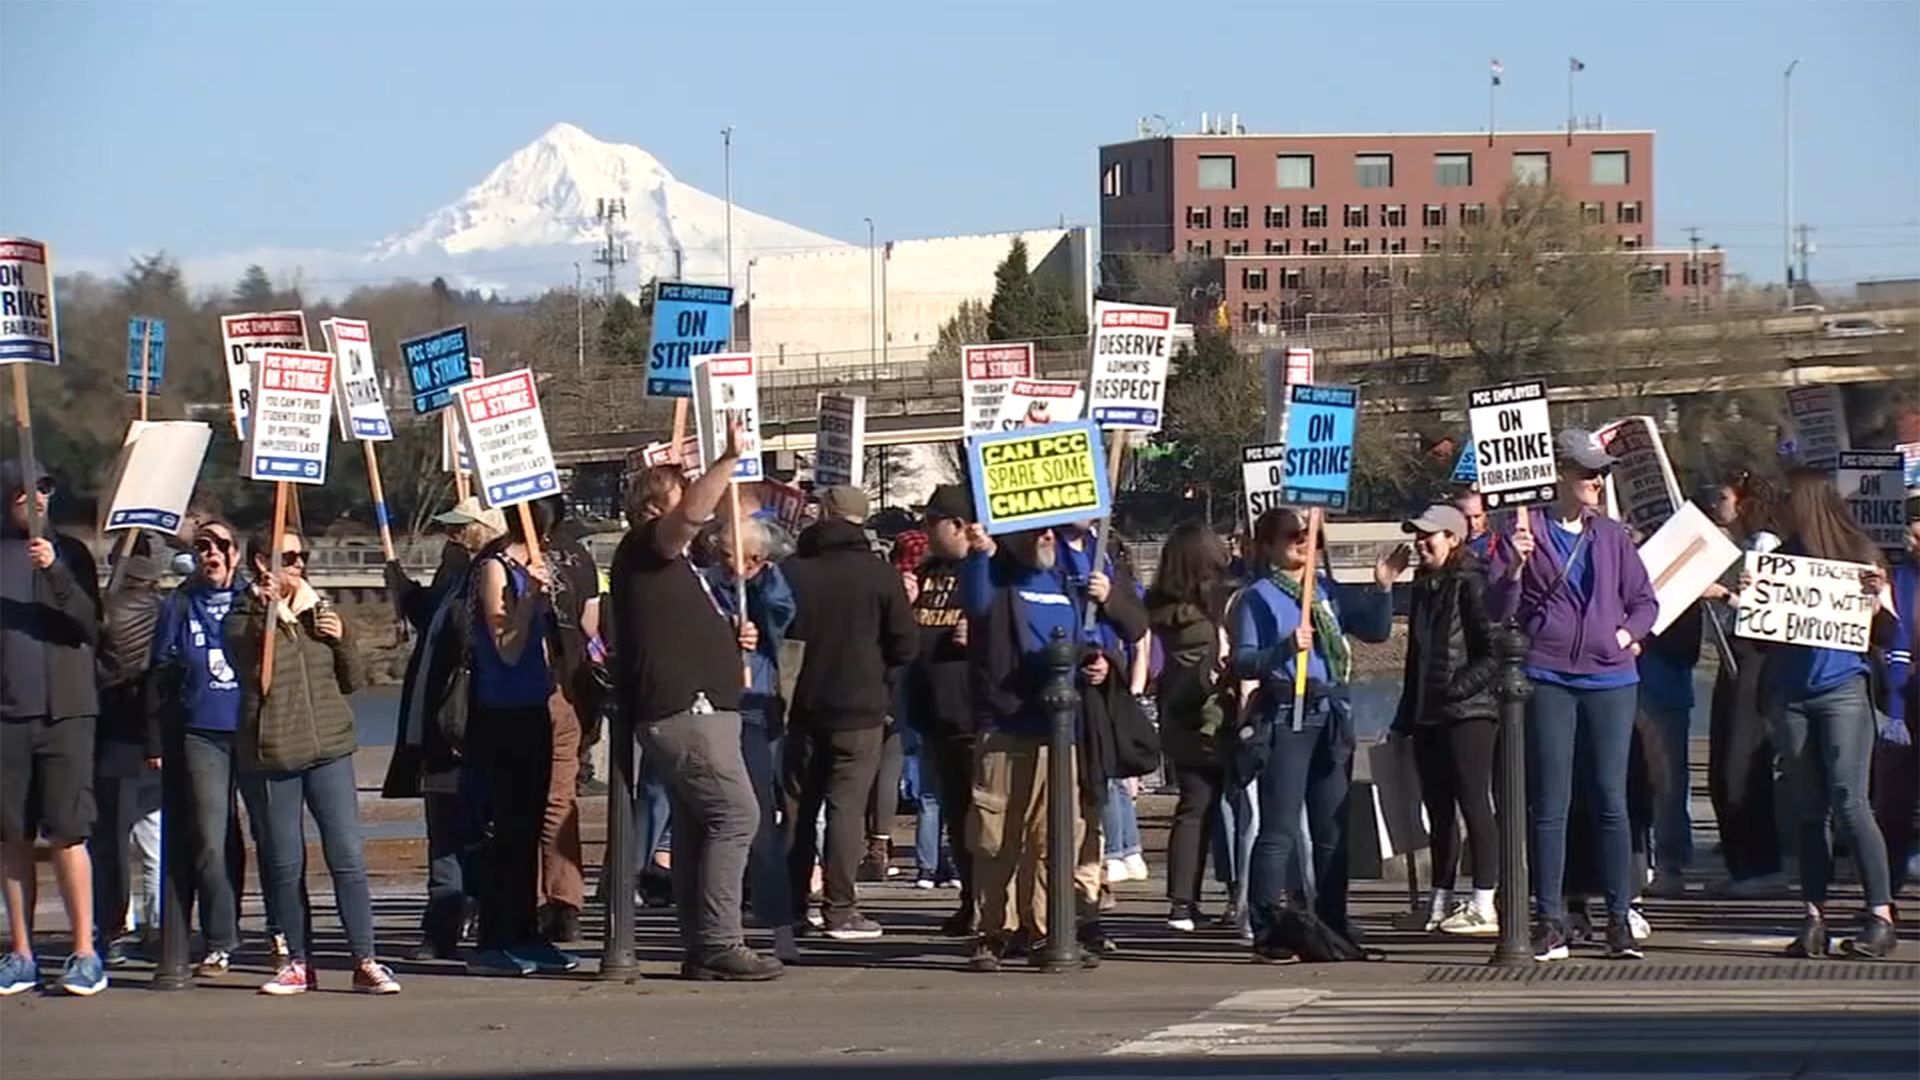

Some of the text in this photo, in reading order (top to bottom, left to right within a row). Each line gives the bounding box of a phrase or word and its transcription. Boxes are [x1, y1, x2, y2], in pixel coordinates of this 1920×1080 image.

[662, 287, 730, 302] PCC EMPLOYEES
[231, 319, 300, 335] PCC EMPLOYEES
[677, 310, 707, 338] ON
[1104, 312, 1164, 327] PCC EMPLOYEES
[407, 333, 464, 363] PCC EMPLOYEES
[969, 350, 986, 362] PCC
[1099, 334, 1165, 357] DESERVE
[267, 355, 328, 372] PCC EMPLOYEES
[412, 353, 468, 391] ON STRIKE
[969, 360, 1027, 377] ON STRIKE
[1106, 360, 1150, 375] ADMIN'S
[265, 370, 327, 392] ON STRIKE
[466, 387, 482, 402] PCC
[482, 378, 527, 400] EMPLOYEES
[1014, 382, 1032, 394] PCC
[1093, 378, 1161, 402] RESPECT
[1294, 387, 1353, 405] PCC EMPLOYEES
[1472, 384, 1541, 405] PCC EMPLOYEES
[469, 392, 532, 423] ON STRIKE
[298, 413, 322, 425] FIRST
[1308, 414, 1335, 443] ON
[1498, 409, 1523, 433] ON
[278, 426, 310, 438] PUTTING
[299, 441, 321, 454] LAST
[985, 434, 1086, 465] CAN PCC
[1246, 447, 1263, 460] PCC
[1477, 432, 1550, 467] STRIKE
[527, 457, 547, 470] LAST
[1285, 446, 1351, 477] STRIKE
[1842, 455, 1857, 467] PCC
[987, 455, 1089, 491] SPARE SOME
[1269, 465, 1280, 486] O
[1481, 462, 1553, 488] FOR FAIR PAY
[1860, 474, 1881, 496] ON
[991, 482, 1094, 516] CHANGE
[1849, 499, 1903, 525] TRIKE
[1757, 554, 1866, 581] PPS TEACHE
[1754, 578, 1874, 614] STAND WITH
[1738, 606, 1867, 647] PCC EMPLOYEES
